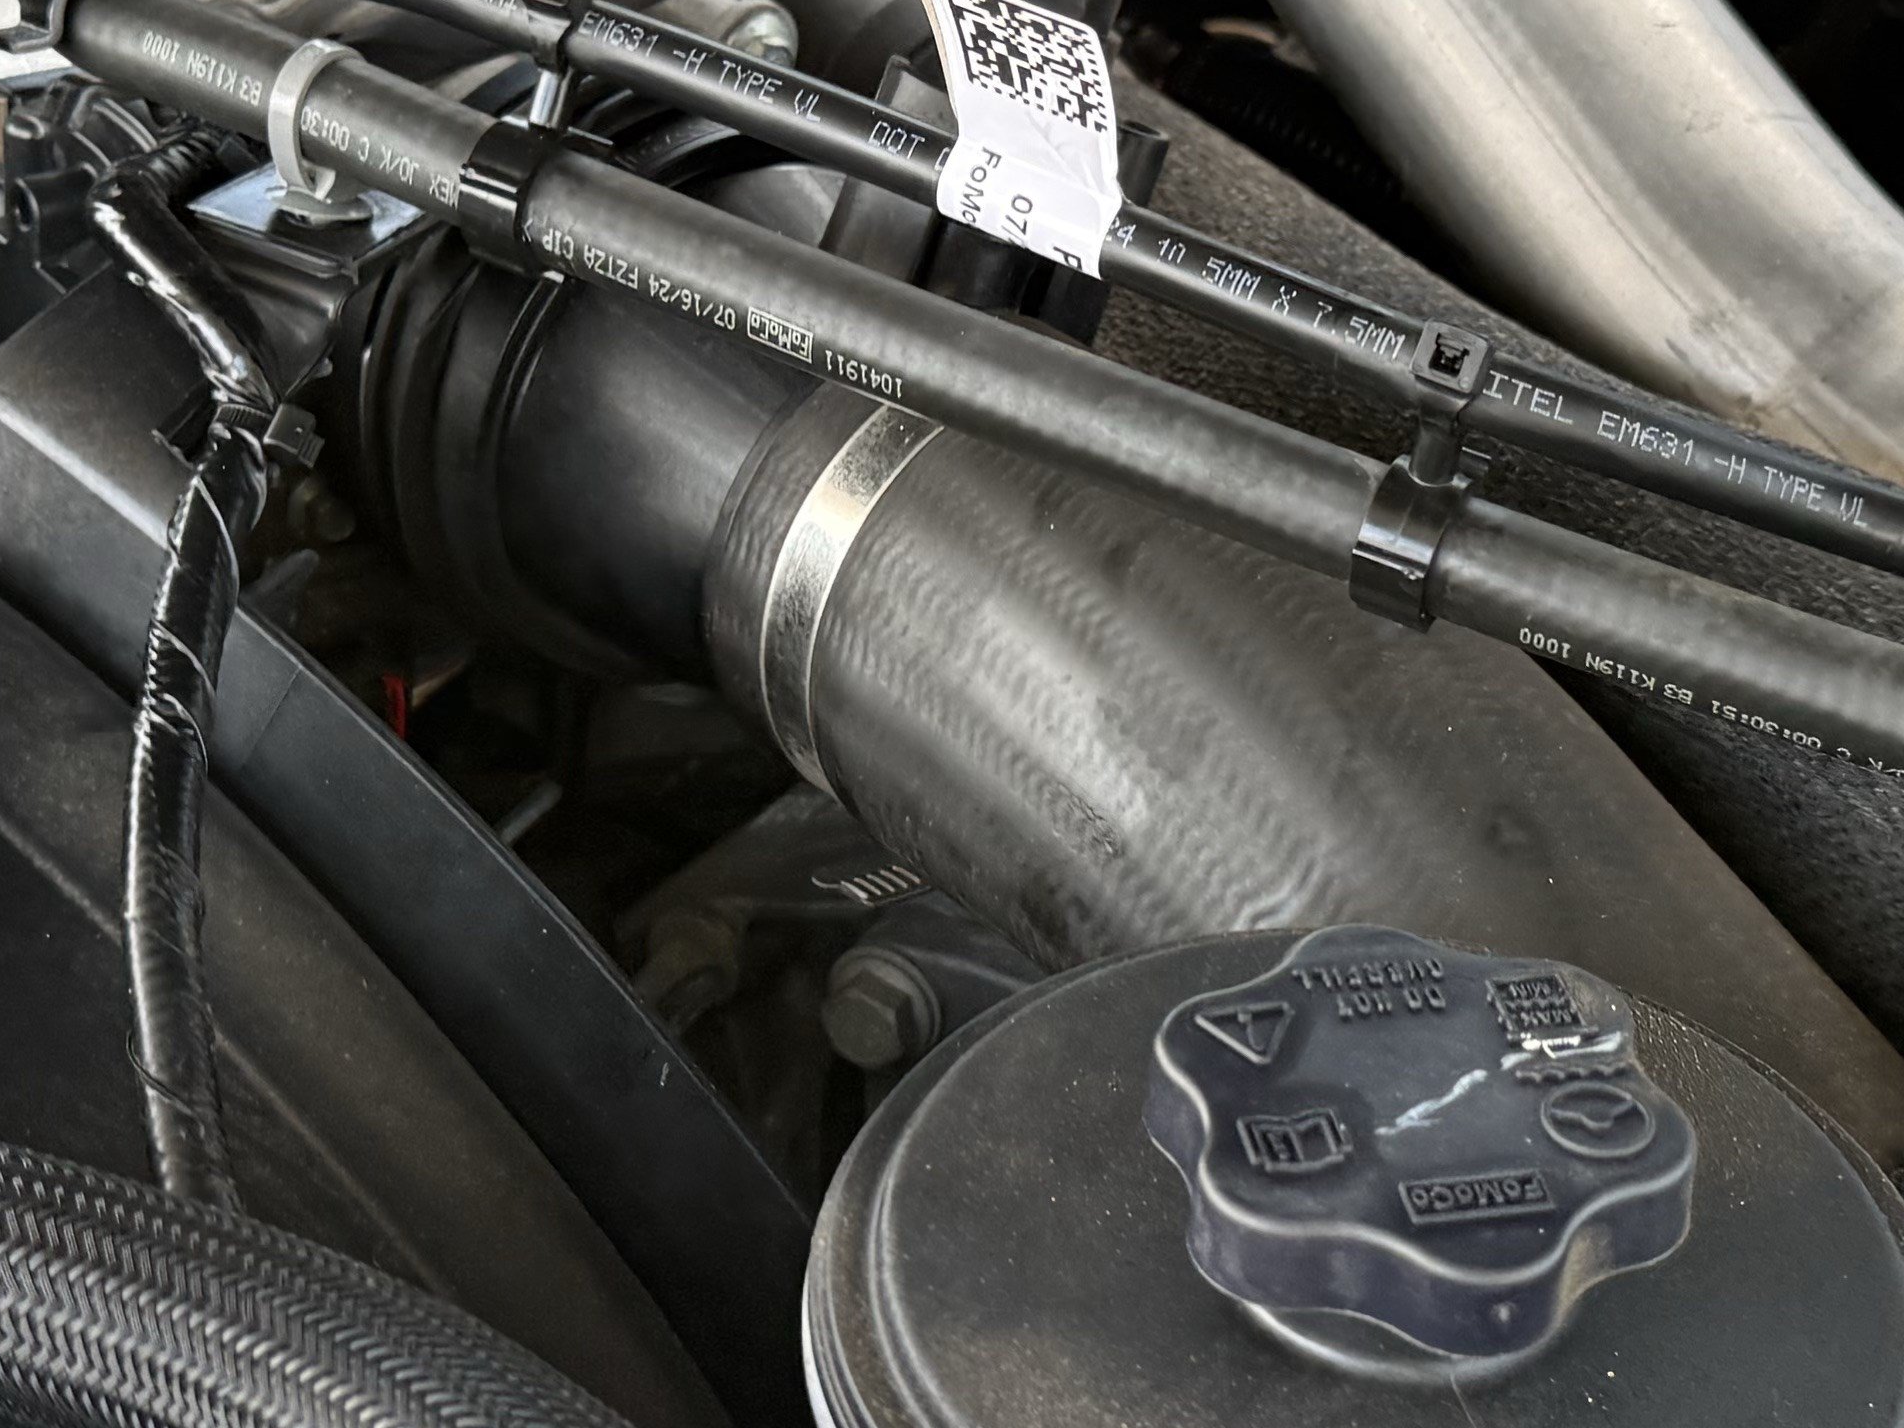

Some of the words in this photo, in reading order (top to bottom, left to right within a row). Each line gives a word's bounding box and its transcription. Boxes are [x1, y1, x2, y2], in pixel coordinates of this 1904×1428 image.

[142, 30, 180, 64] 1000
[578, 11, 659, 58] EM631
[717, 59, 783, 104] TYPE
[794, 88, 822, 123] VL
[187, 48, 238, 93] K119N
[240, 75, 263, 107] B3
[358, 136, 370, 162] C
[868, 120, 926, 160] DOT
[379, 145, 420, 186] JO/K
[542, 227, 575, 260] CIP
[648, 277, 737, 331] 07/16/24
[1270, 284, 1298, 317] X
[1313, 301, 1406, 362] 7.5MM
[749, 309, 812, 361] FoMoCo
[824, 348, 903, 399] 1041911
[1597, 410, 1695, 466] EM631
[1763, 465, 1826, 513] TYPE
[1838, 491, 1868, 529] VL
[1518, 627, 1572, 660] 1000
[1584, 652, 1656, 692] K119N
[1663, 683, 1694, 706] B3
[1711, 698, 1823, 750] 00:30:51
[1291, 958, 1444, 990] OVERFILL
[1336, 990, 1393, 1018] NOT
[1404, 987, 1446, 1011] DO
[1410, 1176, 1545, 1211] FoMoCo
